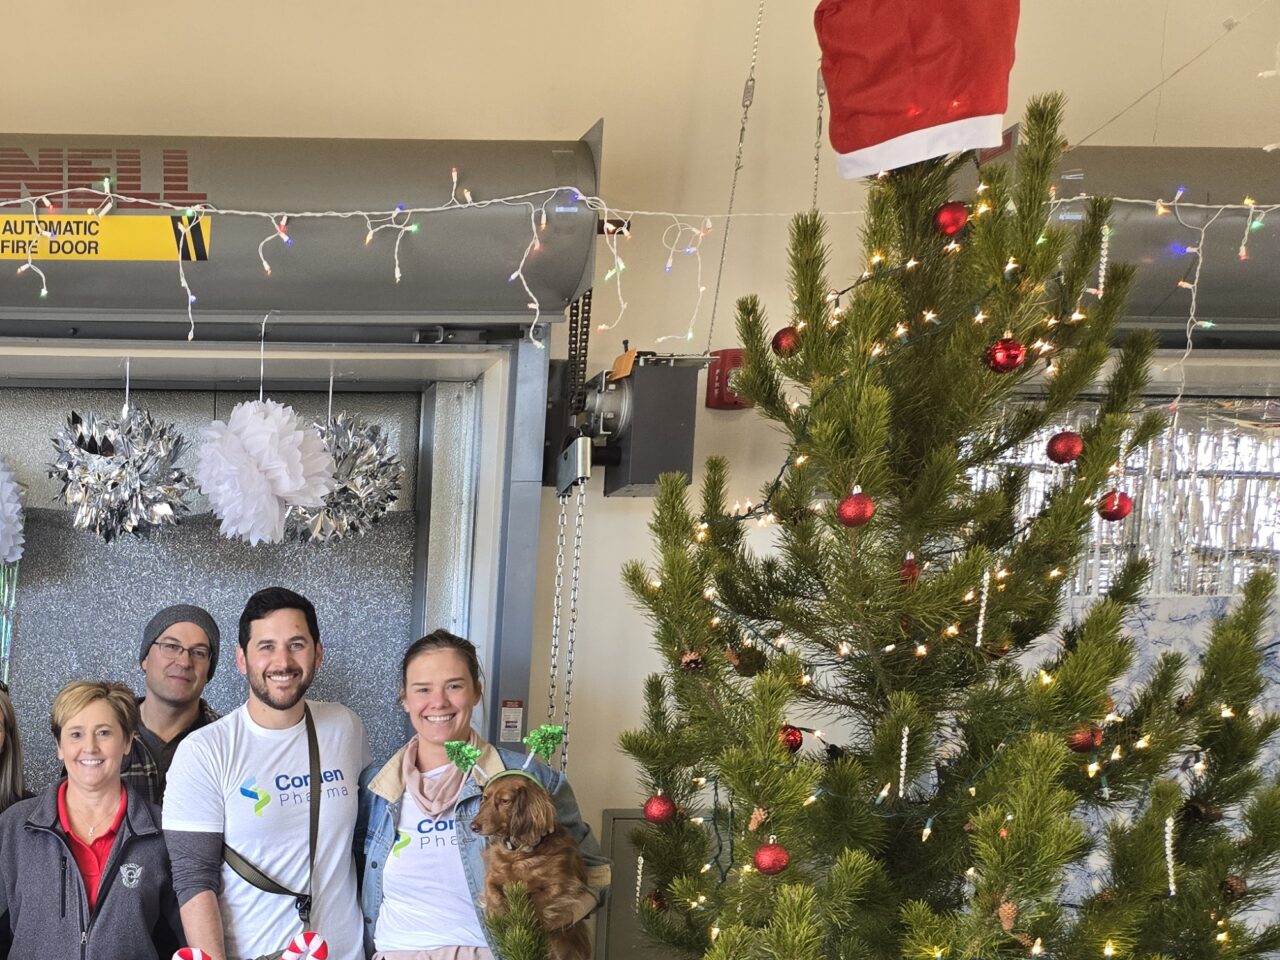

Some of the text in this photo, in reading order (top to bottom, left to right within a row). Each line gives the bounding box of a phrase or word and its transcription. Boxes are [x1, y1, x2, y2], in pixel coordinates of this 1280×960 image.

[2, 220, 100, 236] AUTOMATIC
[0, 240, 38, 254] FIRE
[49, 240, 99, 255] DOOR
[275, 768, 345, 791] Coren
[280, 786, 349, 807] Phama
[417, 818, 456, 834] Cor
[420, 835, 458, 849] Pha
